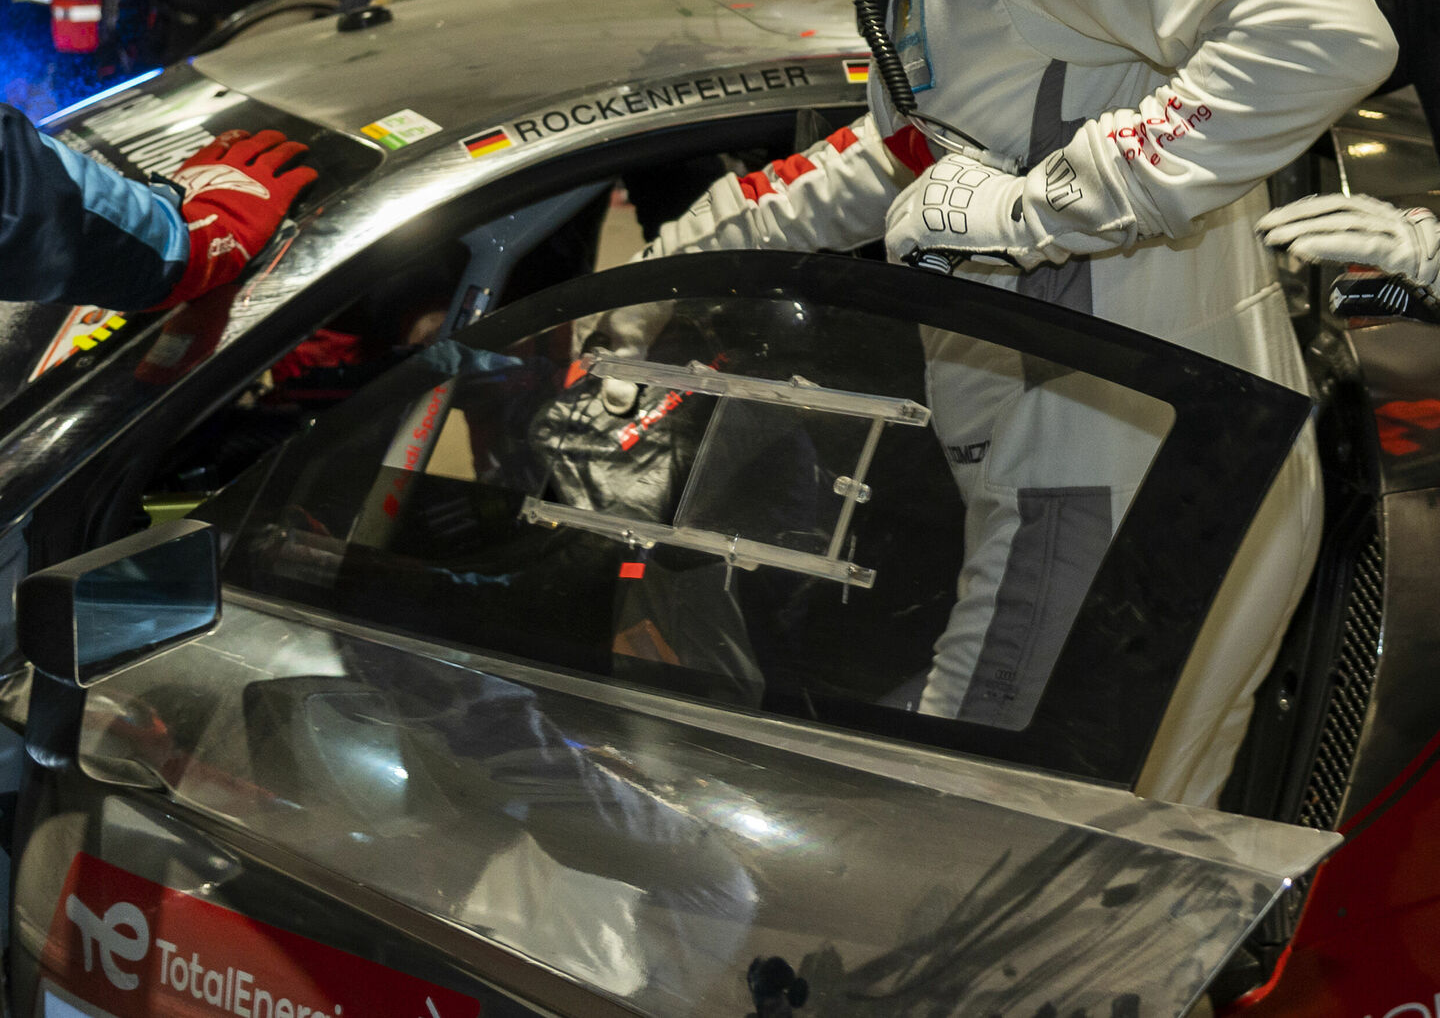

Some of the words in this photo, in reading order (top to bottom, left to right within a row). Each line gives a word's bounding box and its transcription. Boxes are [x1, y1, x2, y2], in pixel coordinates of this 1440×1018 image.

[513, 65, 811, 142] ROCKENFELLER
[1156, 103, 1213, 149] racing
[413, 385, 448, 442] Sport
[155, 938, 345, 1018] TotalEner
